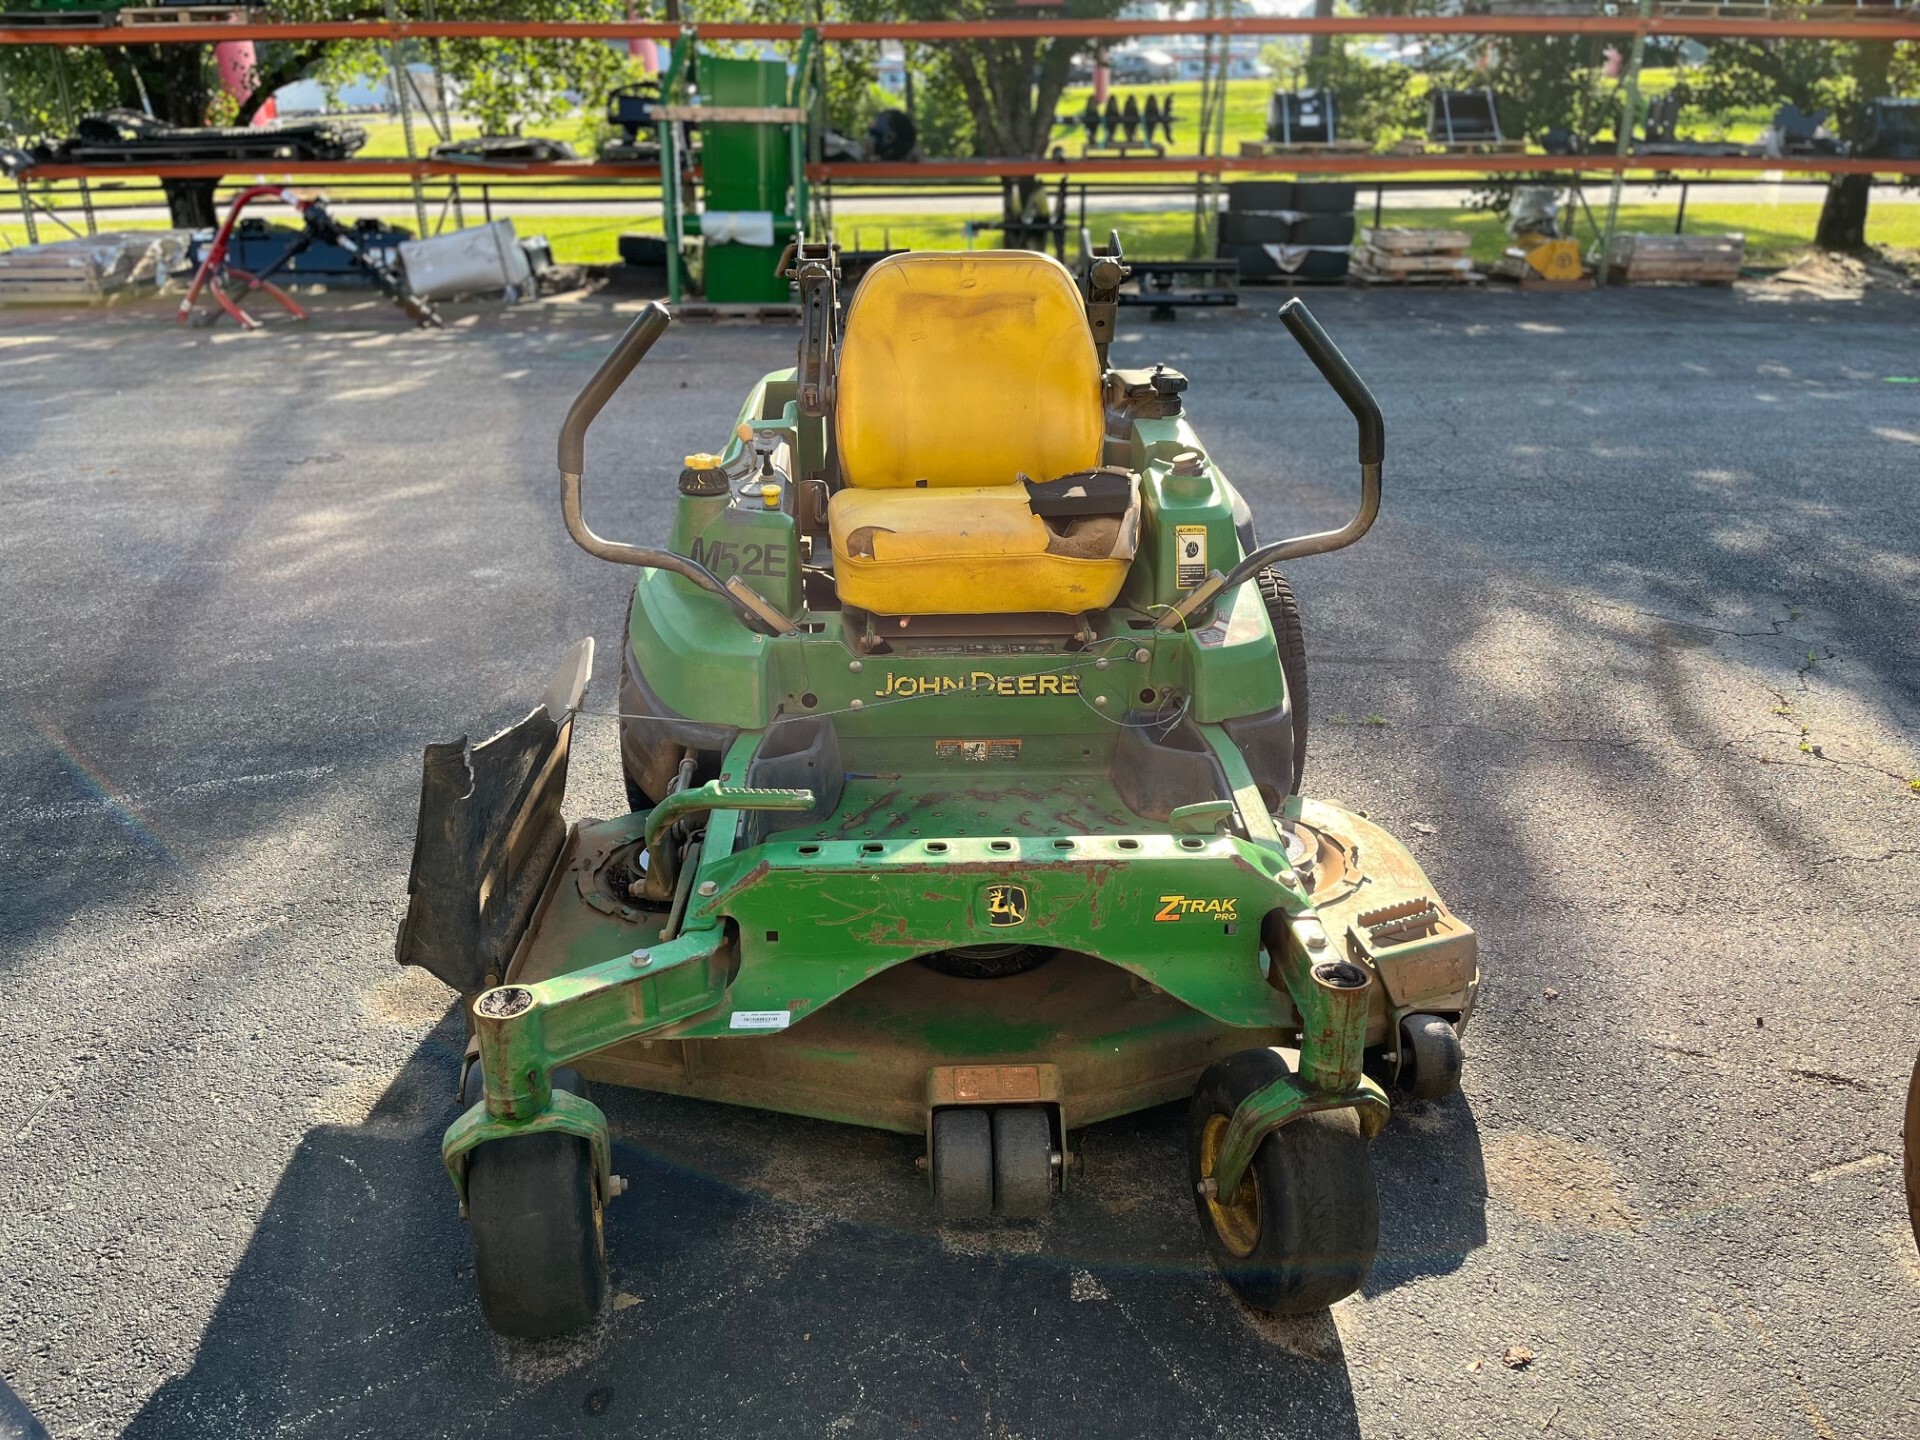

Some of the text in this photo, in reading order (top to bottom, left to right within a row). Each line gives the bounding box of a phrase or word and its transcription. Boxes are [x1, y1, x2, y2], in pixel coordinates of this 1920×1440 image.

[690, 536, 787, 578] M52E
[875, 671, 1081, 697] JOHN DEERE
[1213, 912, 1237, 921] PRO
